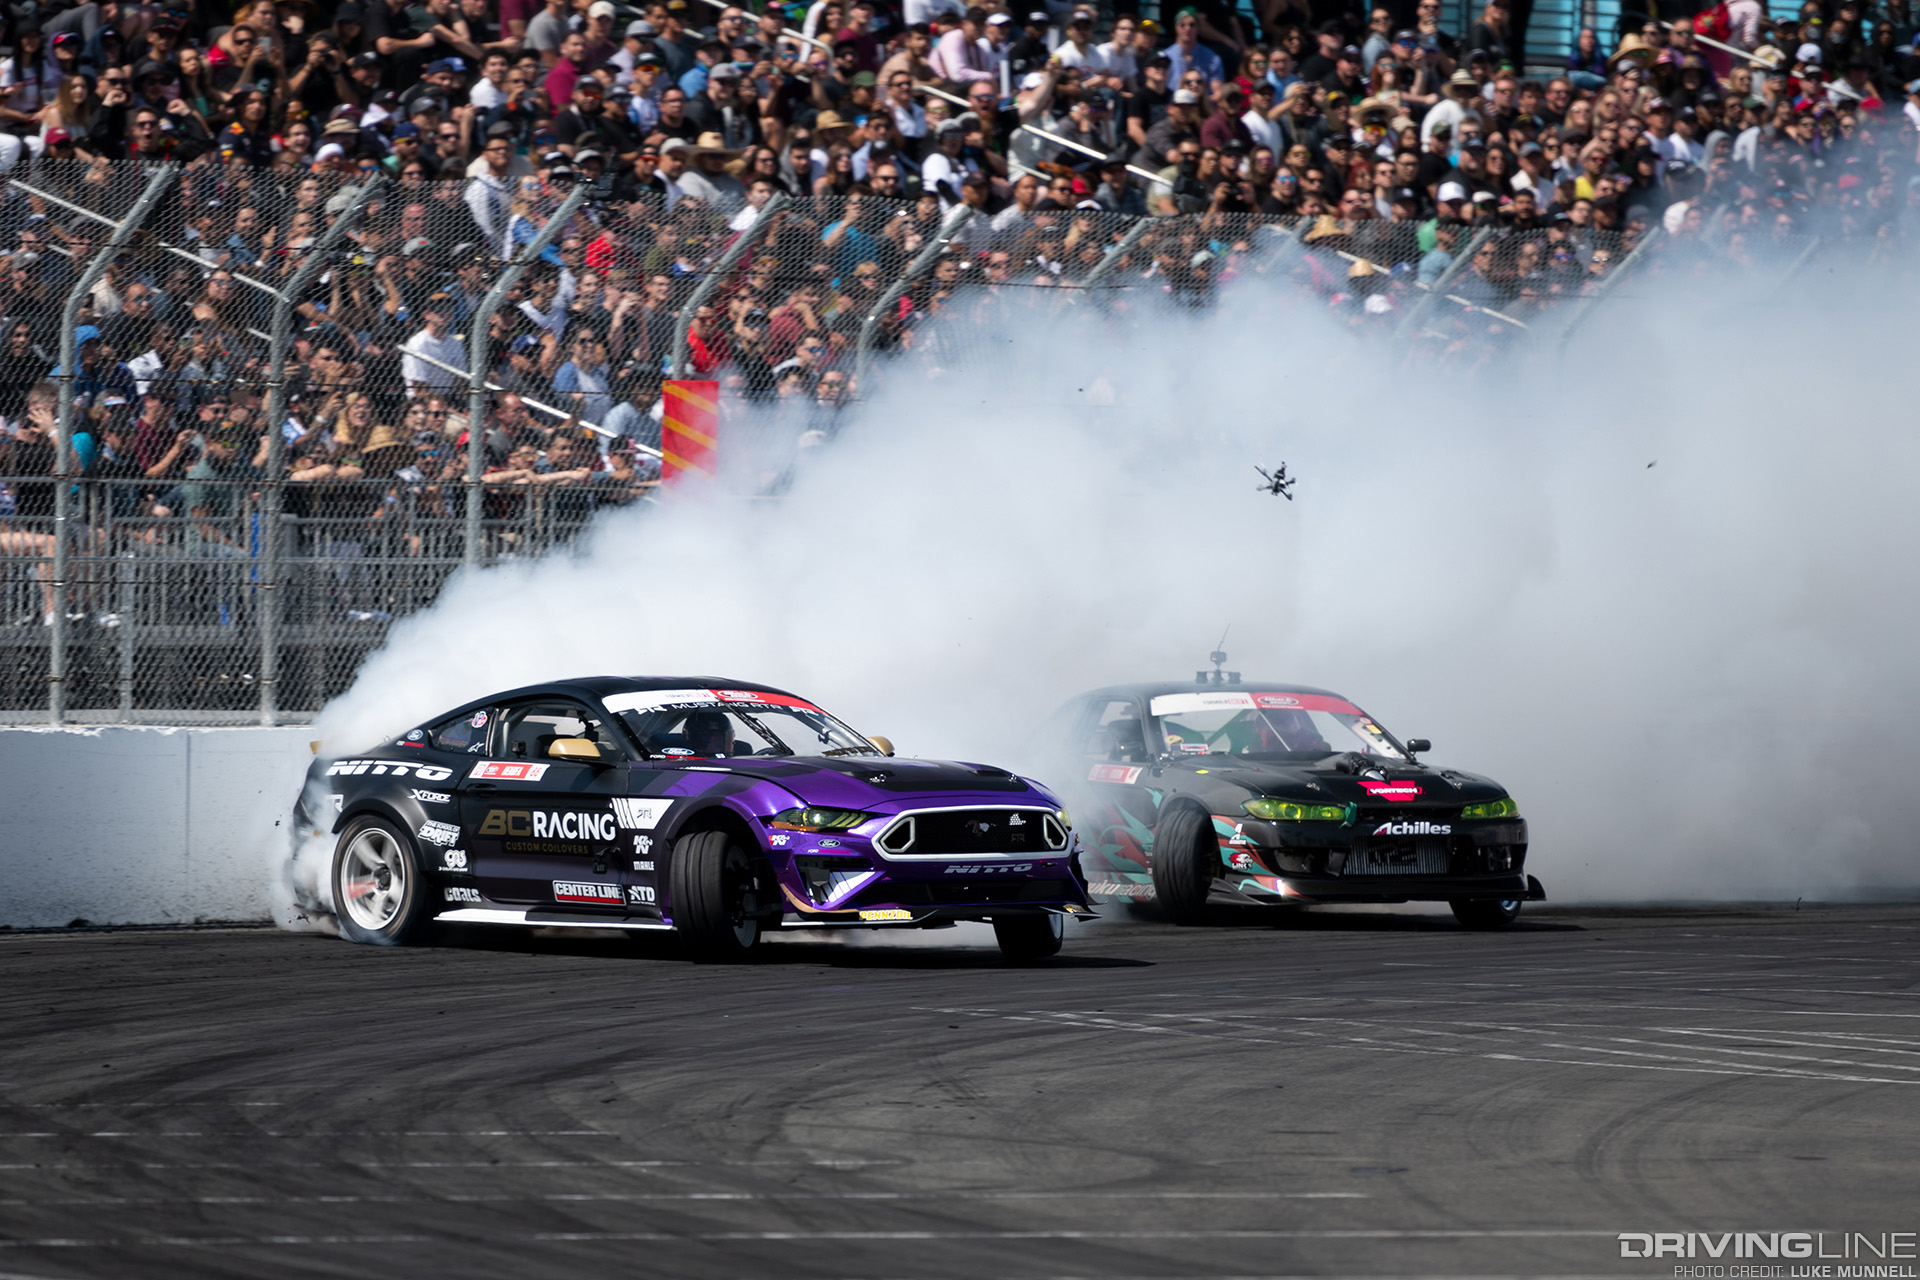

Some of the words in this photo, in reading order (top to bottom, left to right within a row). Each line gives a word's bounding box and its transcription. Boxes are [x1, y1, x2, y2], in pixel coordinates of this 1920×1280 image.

[671, 702, 748, 710] MUSTANG
[325, 760, 453, 781] NITTO
[1373, 822, 1451, 836] Achilles
[506, 841, 540, 851] CUSTOM
[542, 843, 589, 855] COILOVERS
[944, 863, 1033, 874] NITTO
[555, 883, 597, 899] CENTER
[597, 886, 623, 899] LINE
[858, 910, 914, 922] PENNZOIL
